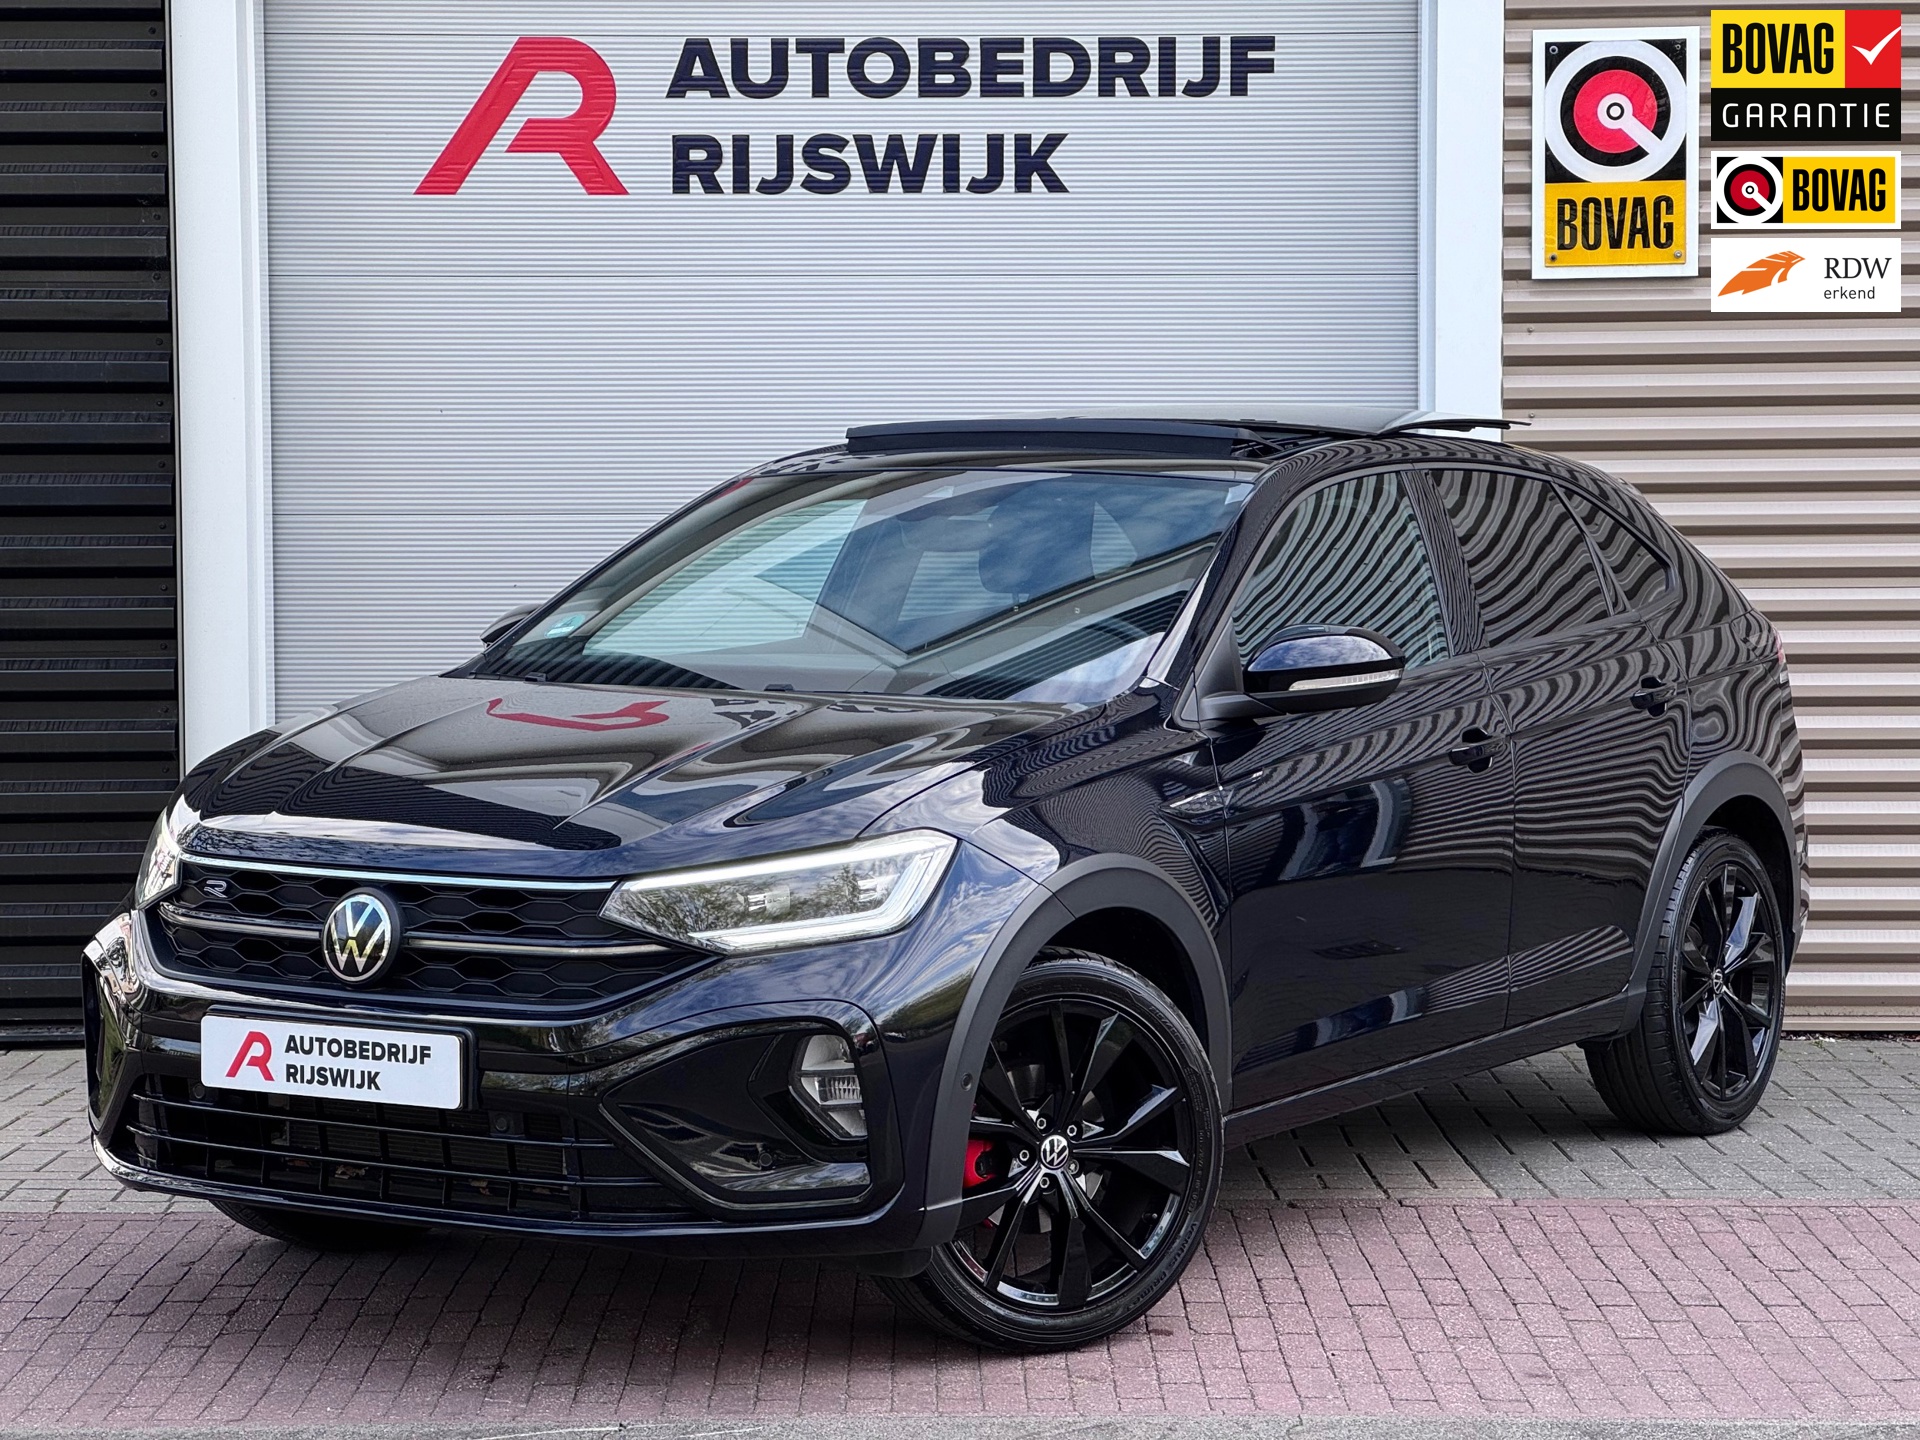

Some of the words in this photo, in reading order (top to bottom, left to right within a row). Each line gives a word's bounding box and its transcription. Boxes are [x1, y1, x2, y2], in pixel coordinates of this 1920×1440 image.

[665, 36, 1276, 99] AUTOBEDRIJF
[671, 132, 1070, 195] RIJSWIJK
[1557, 195, 1674, 251] BOVAG
[285, 1034, 432, 1065] AUTOBEDRIJF
[285, 1063, 381, 1091] RIJSWIJK
